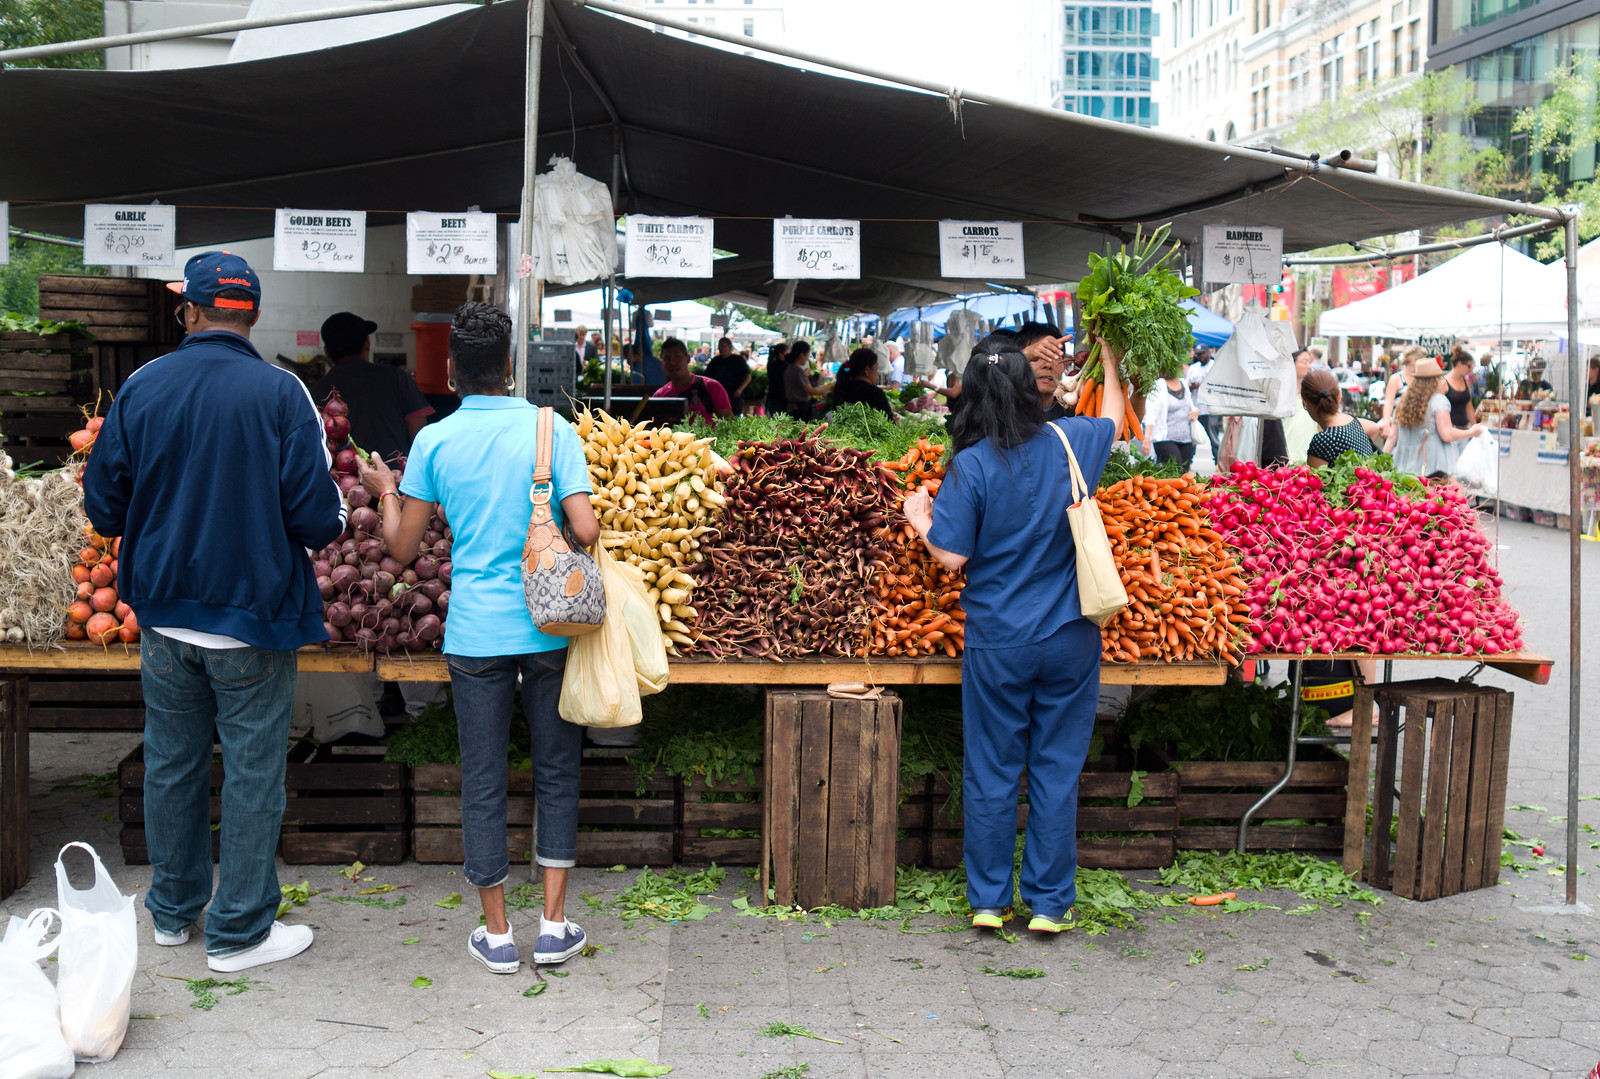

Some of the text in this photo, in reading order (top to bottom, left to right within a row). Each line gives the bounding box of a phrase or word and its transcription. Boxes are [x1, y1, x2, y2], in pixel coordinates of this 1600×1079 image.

[114, 211, 147, 221] GARLIC
[290, 216, 351, 227] GOLDEN BEETS
[441, 218, 467, 228] BEETS
[637, 223, 704, 234] WHITE CARROTS
[782, 225, 854, 236] PURPLE CARROTS
[962, 226, 999, 236] CARROTS
[1226, 231, 1263, 241] RADISHES
[1421, 334, 1456, 347] MAPLE
